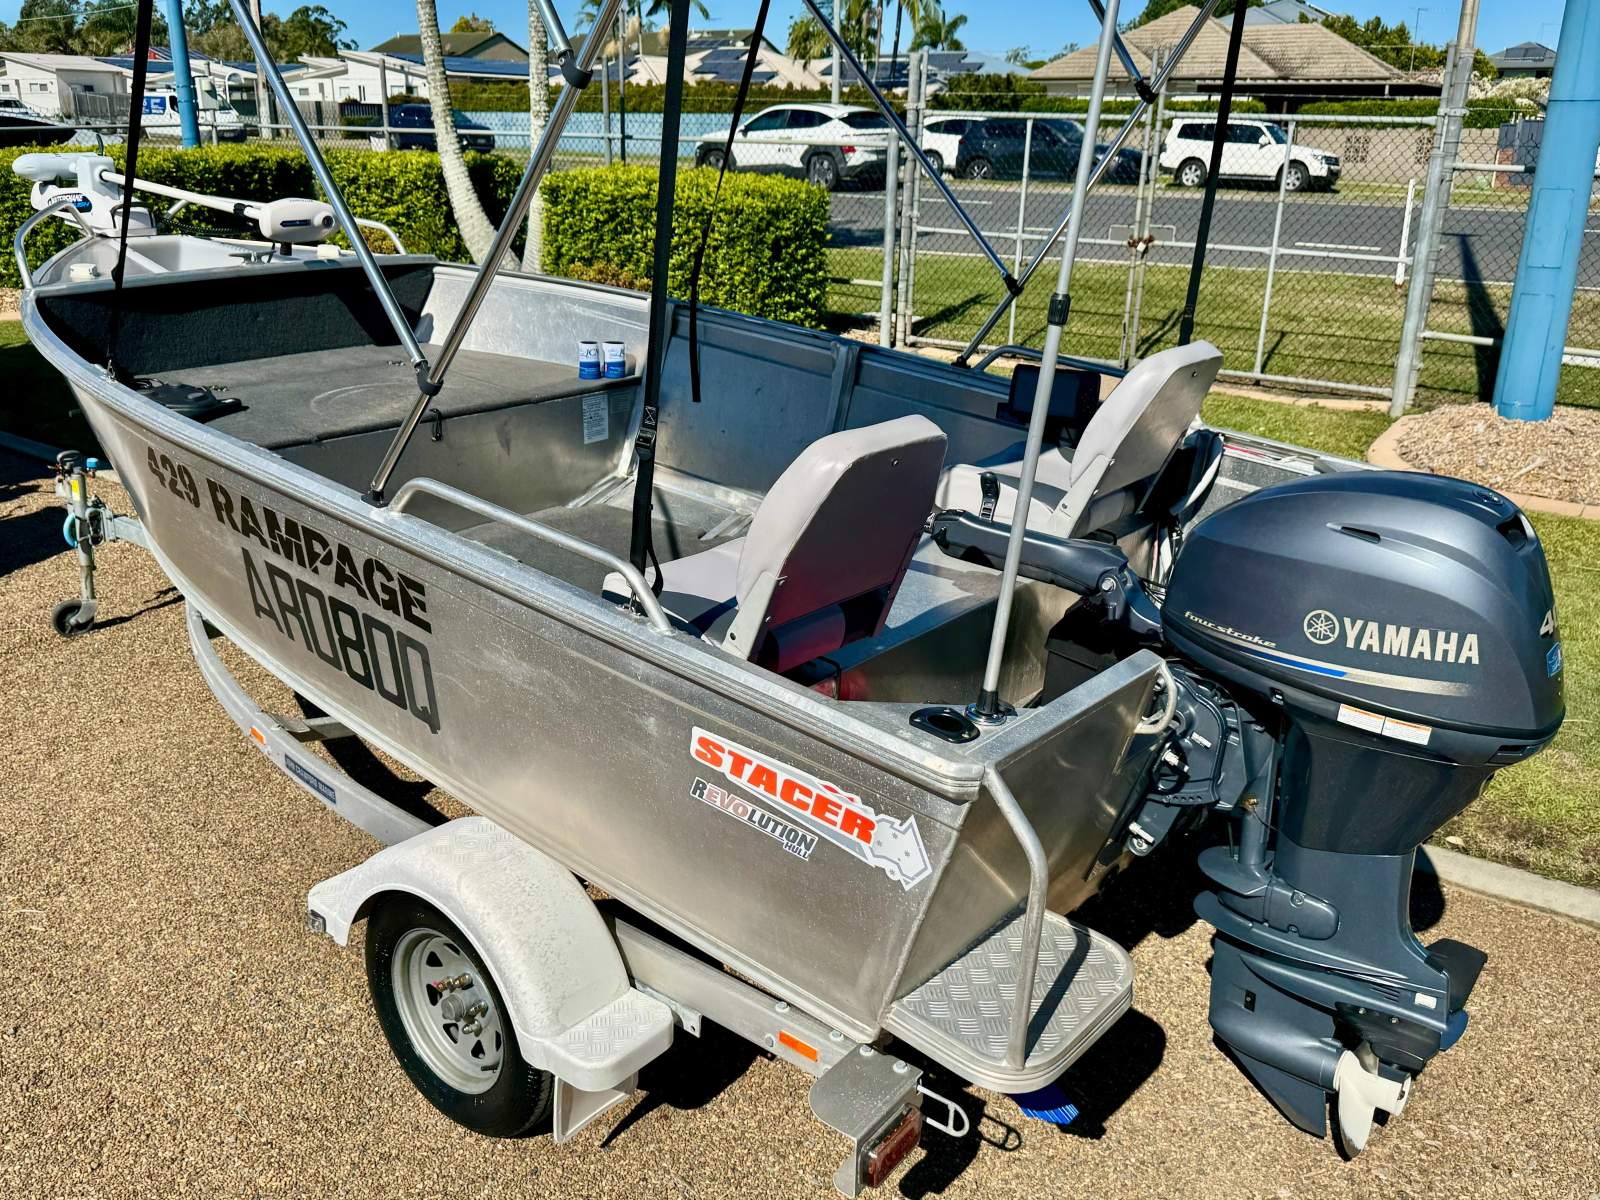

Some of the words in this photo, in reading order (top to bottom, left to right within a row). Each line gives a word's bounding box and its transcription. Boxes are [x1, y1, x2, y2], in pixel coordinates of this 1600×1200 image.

[147, 446, 201, 508] 429
[206, 478, 433, 634] RAMPAGE
[1343, 617, 1479, 664] YAMAHA
[692, 779, 815, 851] REVOLUTION
[694, 736, 876, 844] STACER
[784, 842, 809, 859] HULL
